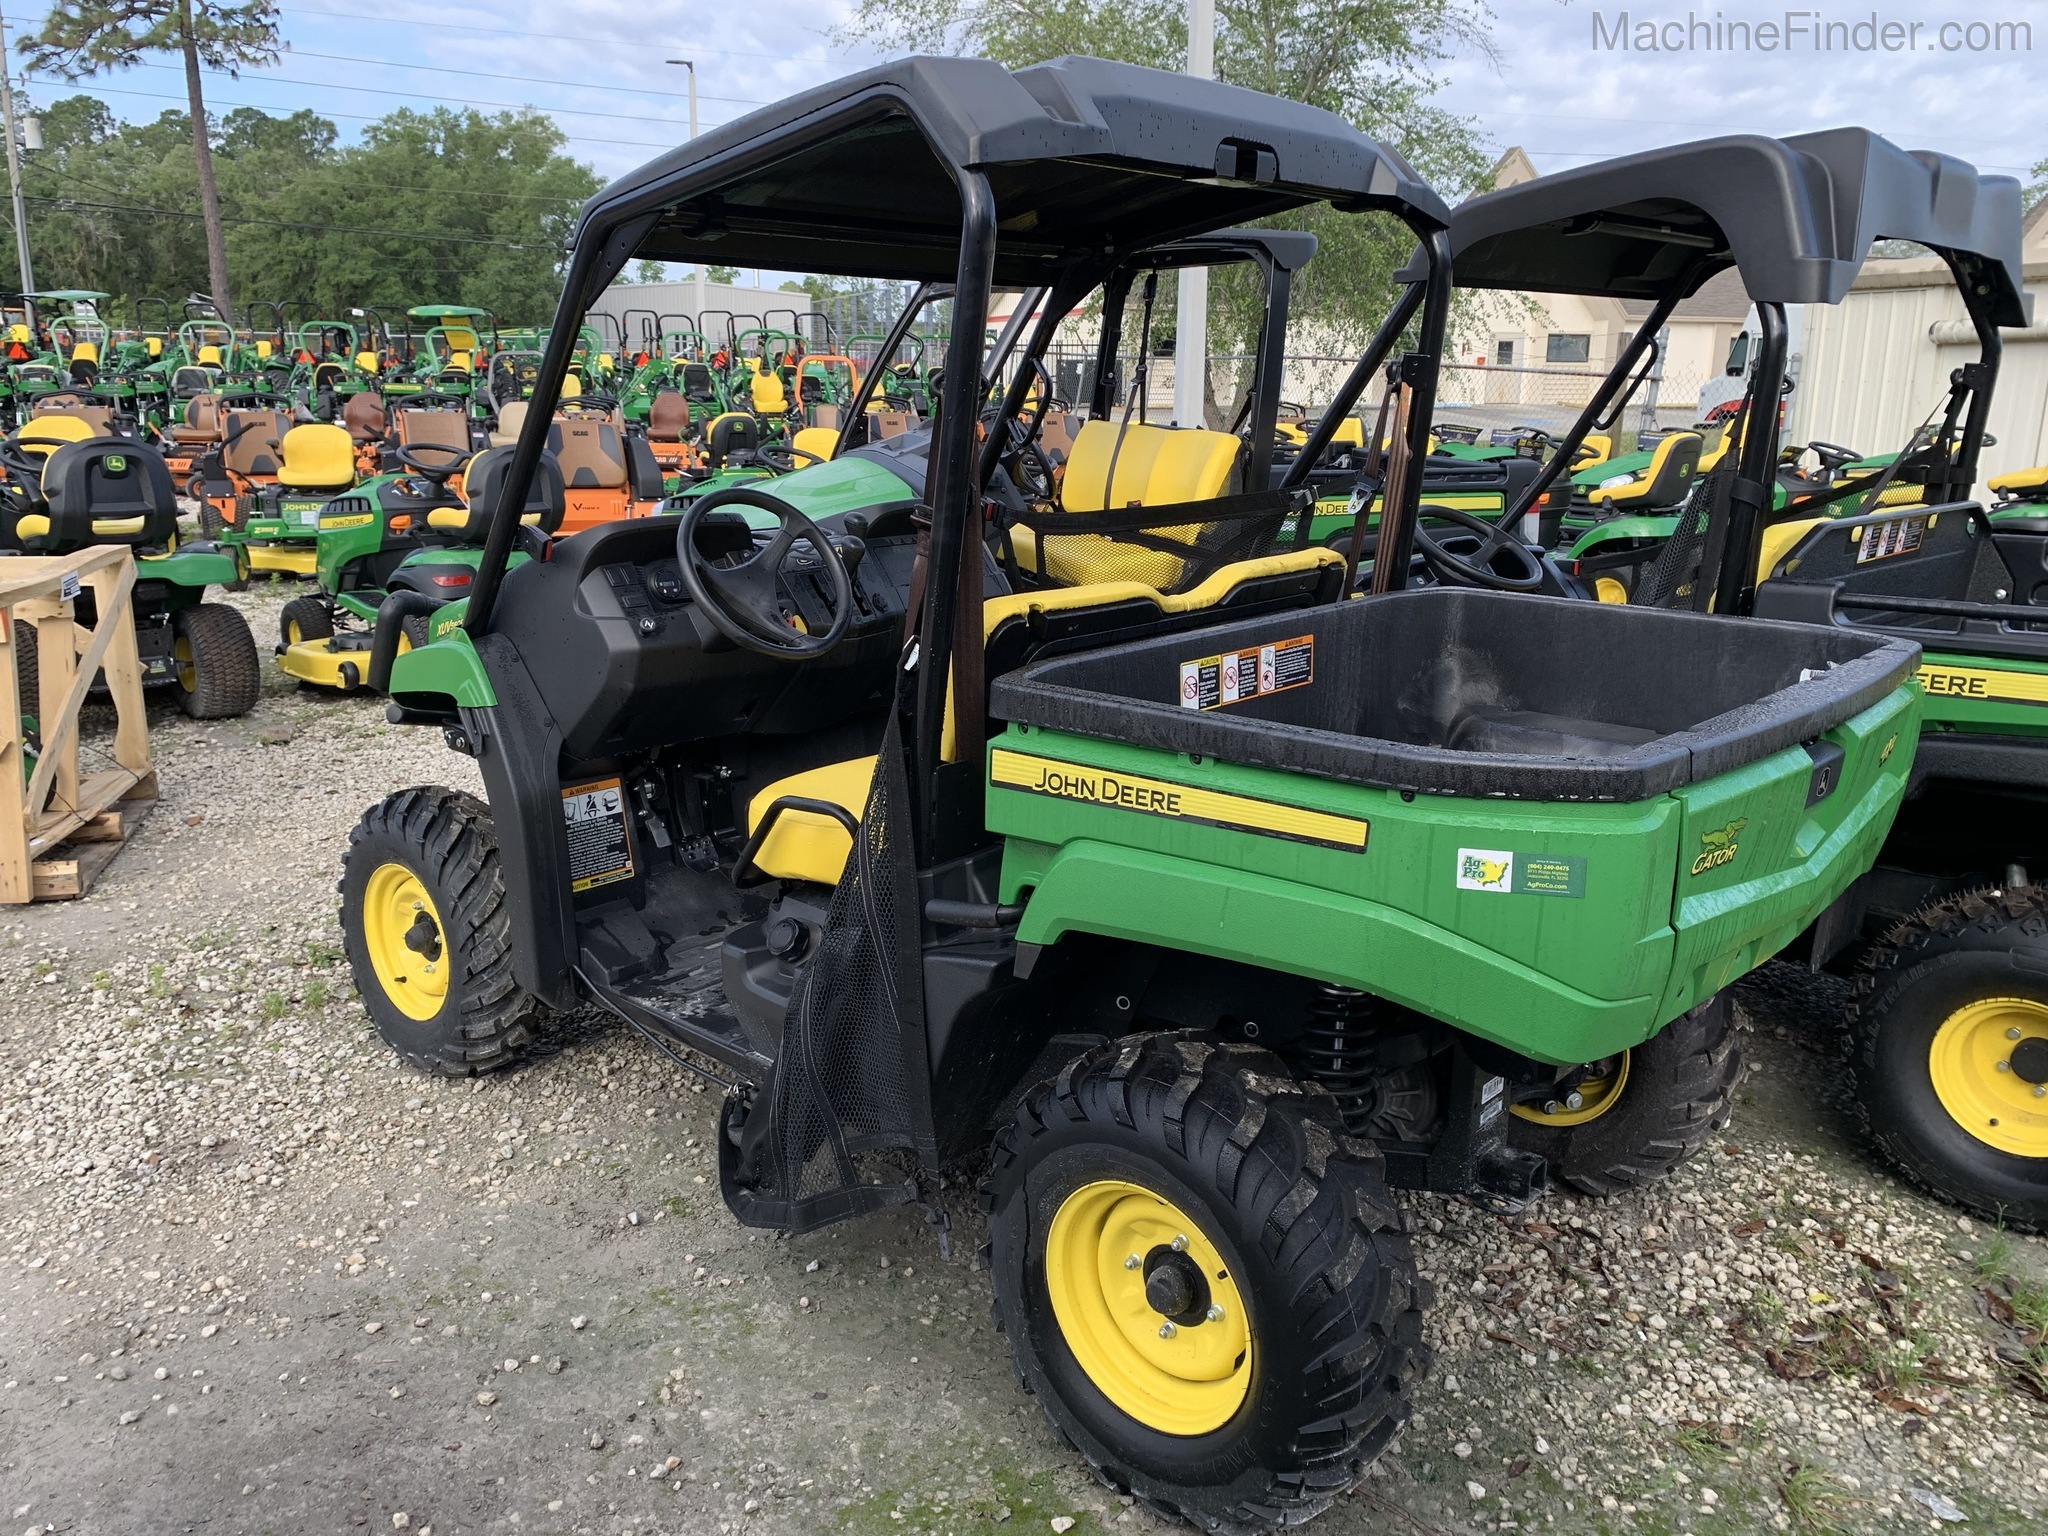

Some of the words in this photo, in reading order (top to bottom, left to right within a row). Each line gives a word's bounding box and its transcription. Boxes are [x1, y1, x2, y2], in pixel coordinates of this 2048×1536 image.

[283, 503, 309, 511] JOHN
[575, 783, 599, 794] WARNING
[1034, 767, 1096, 798] JOHN
[1102, 778, 1181, 814] DEERE
[1463, 856, 1486, 869] Ag-
[1691, 843, 1739, 876] GATOR
[1463, 866, 1485, 878] Pro
[1527, 881, 1568, 890] AgProCo.com
